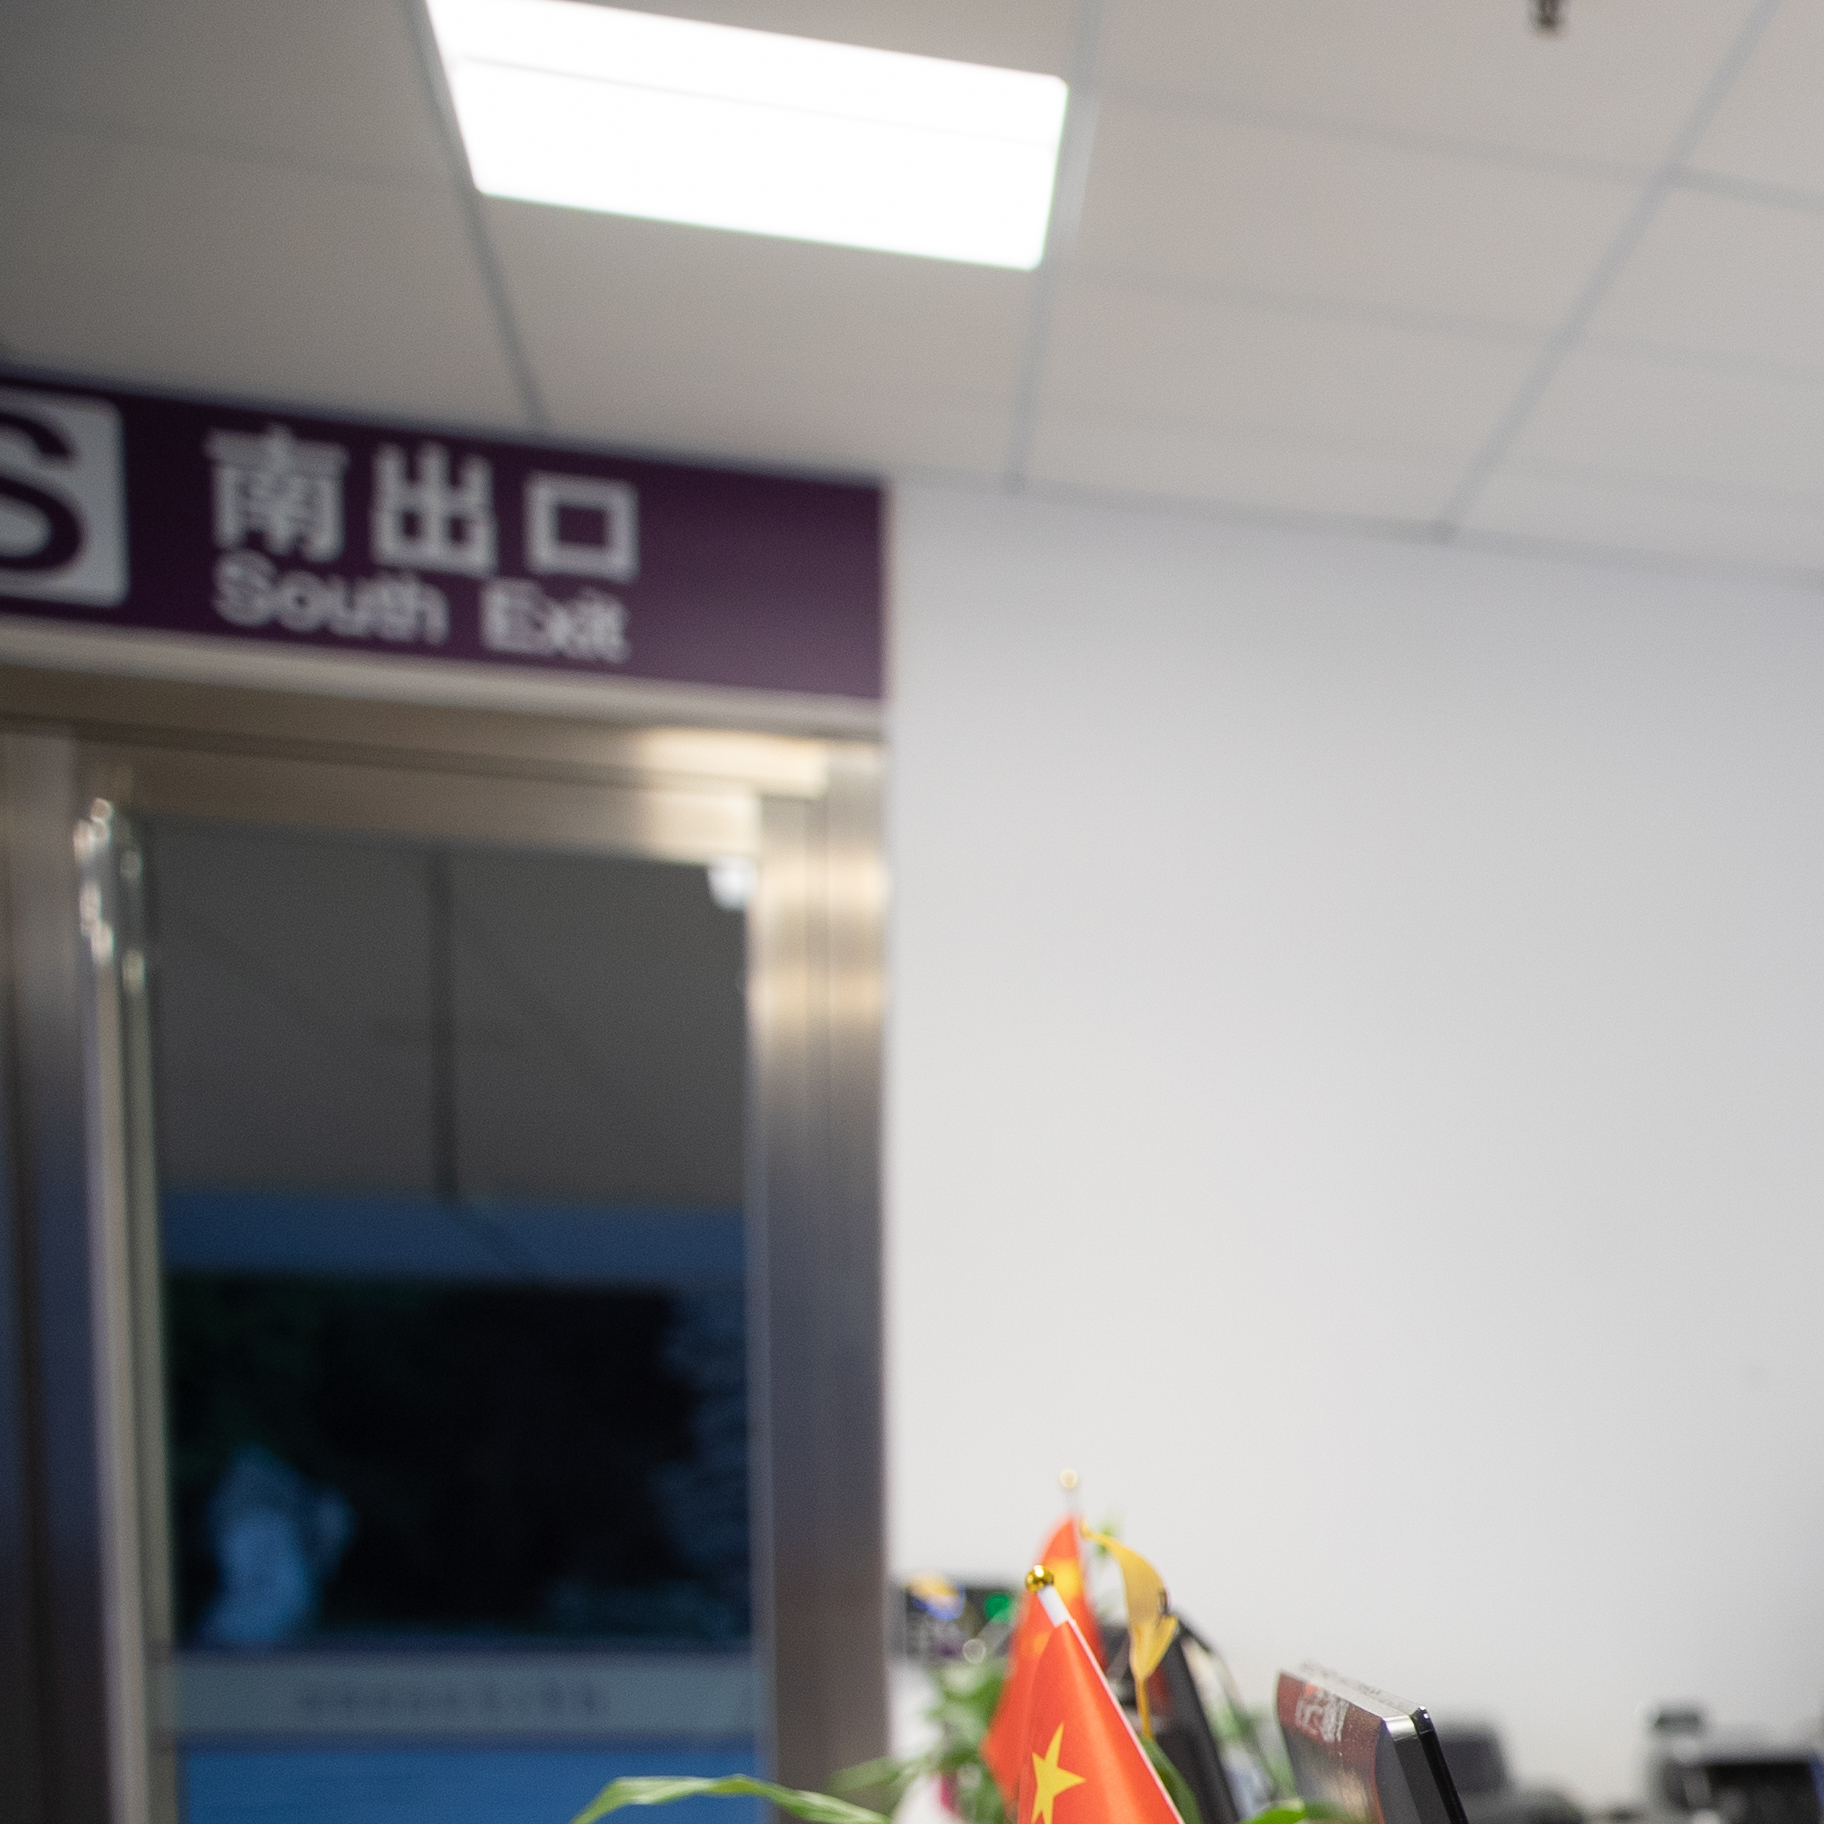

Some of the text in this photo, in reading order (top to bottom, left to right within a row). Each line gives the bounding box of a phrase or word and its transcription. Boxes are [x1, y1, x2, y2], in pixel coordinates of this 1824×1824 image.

[207, 421, 642, 584] 南出口
[211, 547, 630, 667] South Exit
